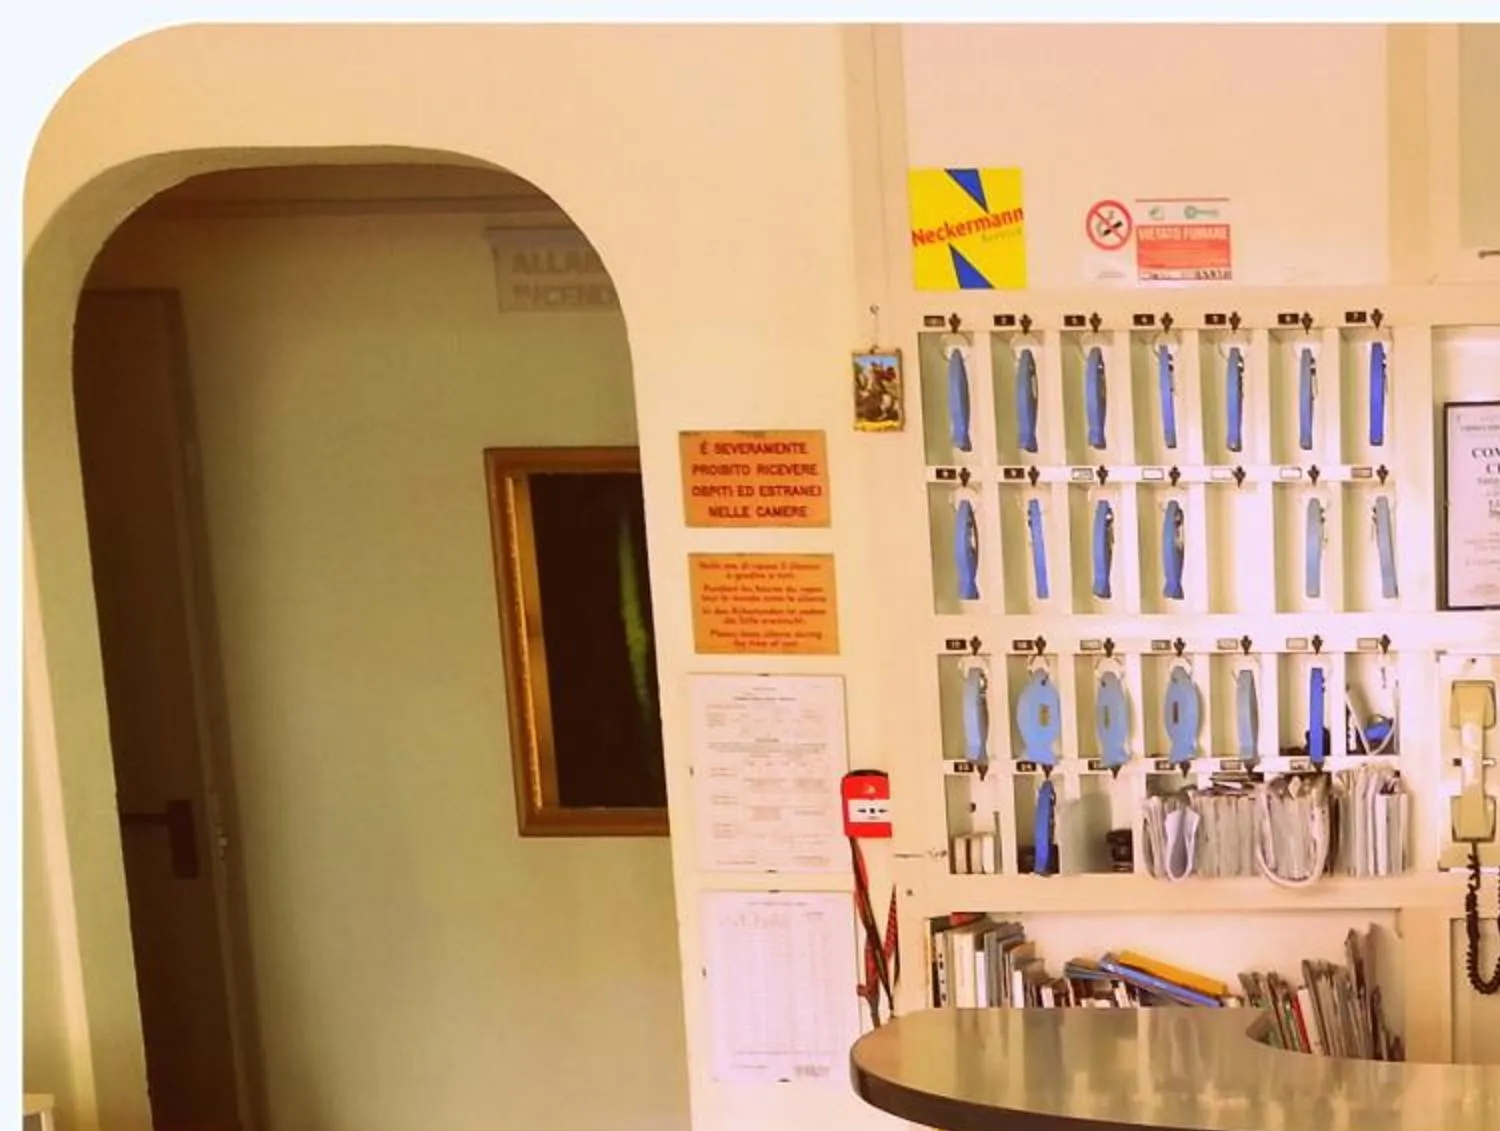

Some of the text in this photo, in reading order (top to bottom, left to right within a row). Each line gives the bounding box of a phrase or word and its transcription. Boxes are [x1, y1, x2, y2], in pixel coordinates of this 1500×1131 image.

[911, 207, 1024, 247] Neckermann
[714, 442, 809, 455] SEVERAMENTE
[692, 463, 819, 476] PROIBITO RICEVERE
[692, 485, 822, 497] OSPITI ED ESTRANEI
[708, 505, 808, 518] NELLE CAMERE
